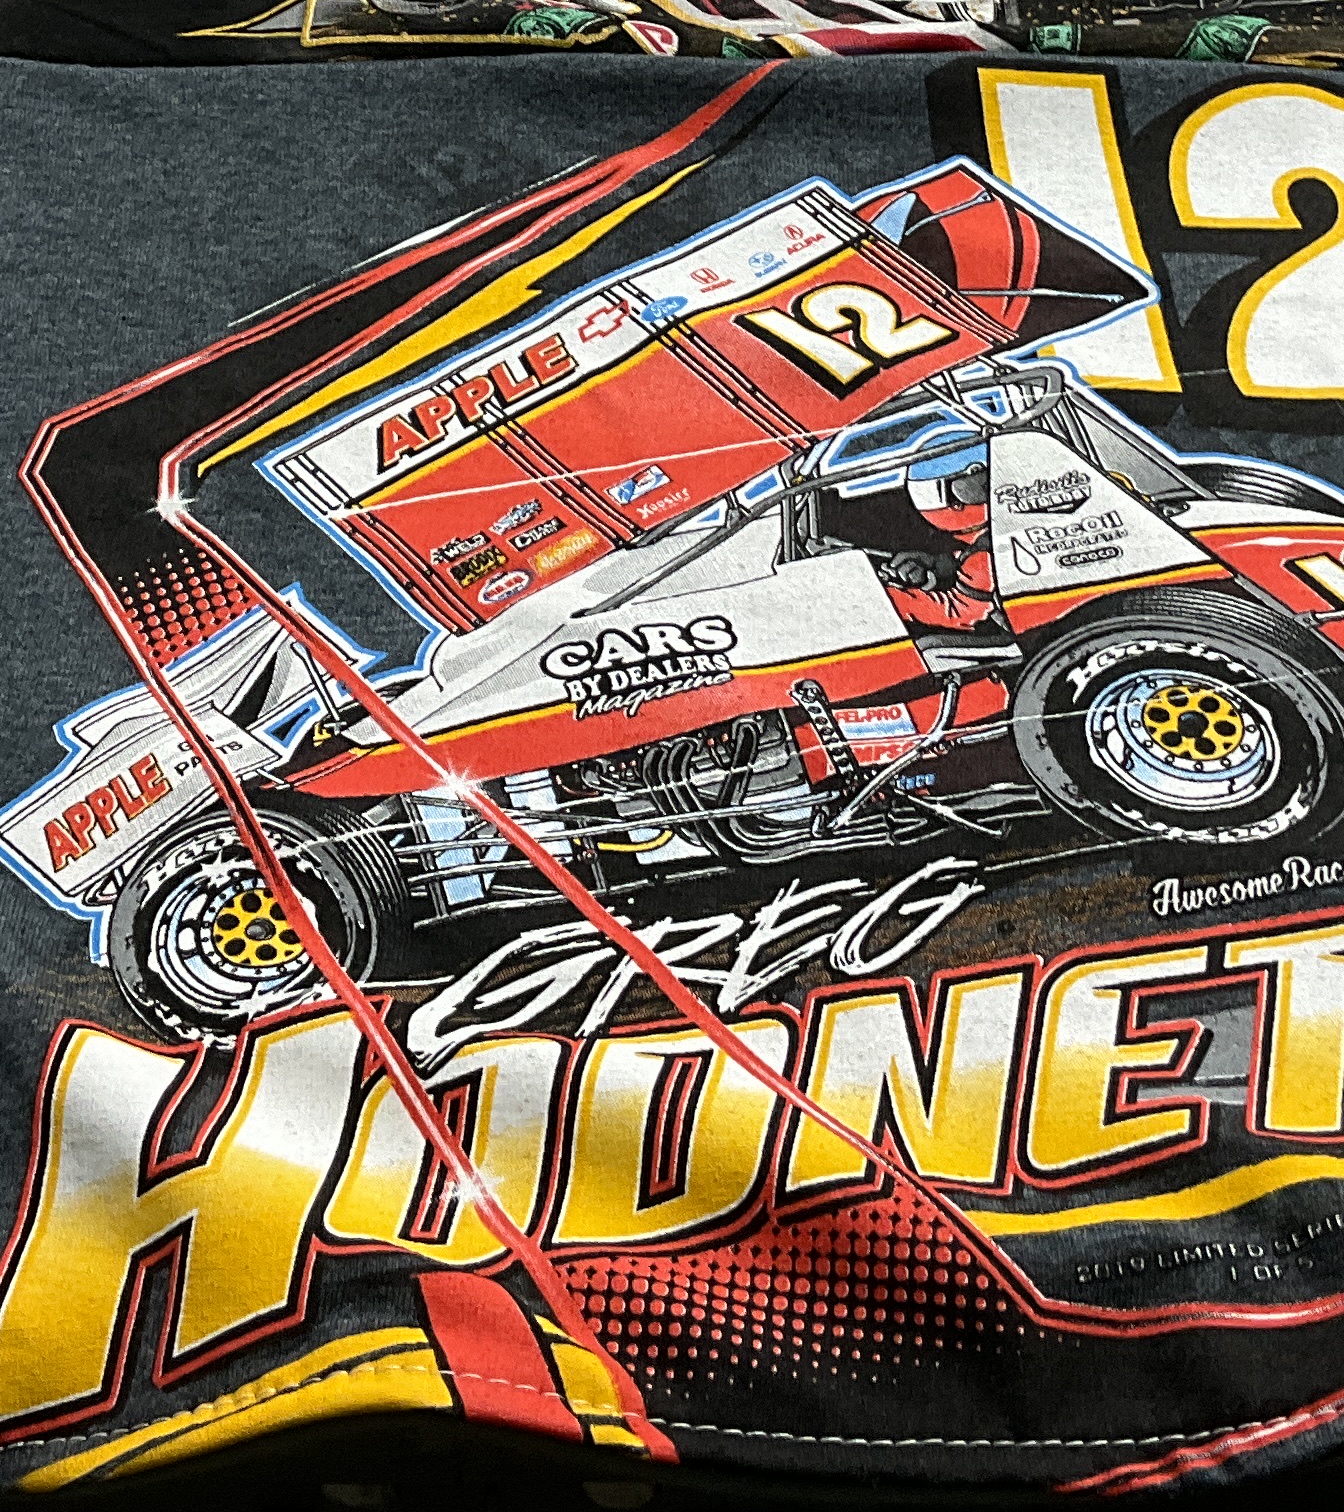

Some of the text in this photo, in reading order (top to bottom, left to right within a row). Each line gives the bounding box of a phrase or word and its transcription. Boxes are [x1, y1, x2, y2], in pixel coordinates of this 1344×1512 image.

[786, 233, 825, 256] ACURA
[736, 281, 955, 390] 12
[377, 333, 580, 474] APPLE
[636, 487, 692, 519] Hoosier
[539, 614, 737, 680] CARS
[566, 650, 732, 703] BY DEALERS
[575, 671, 733, 719] Magazine
[39, 752, 174, 872] APPLE
